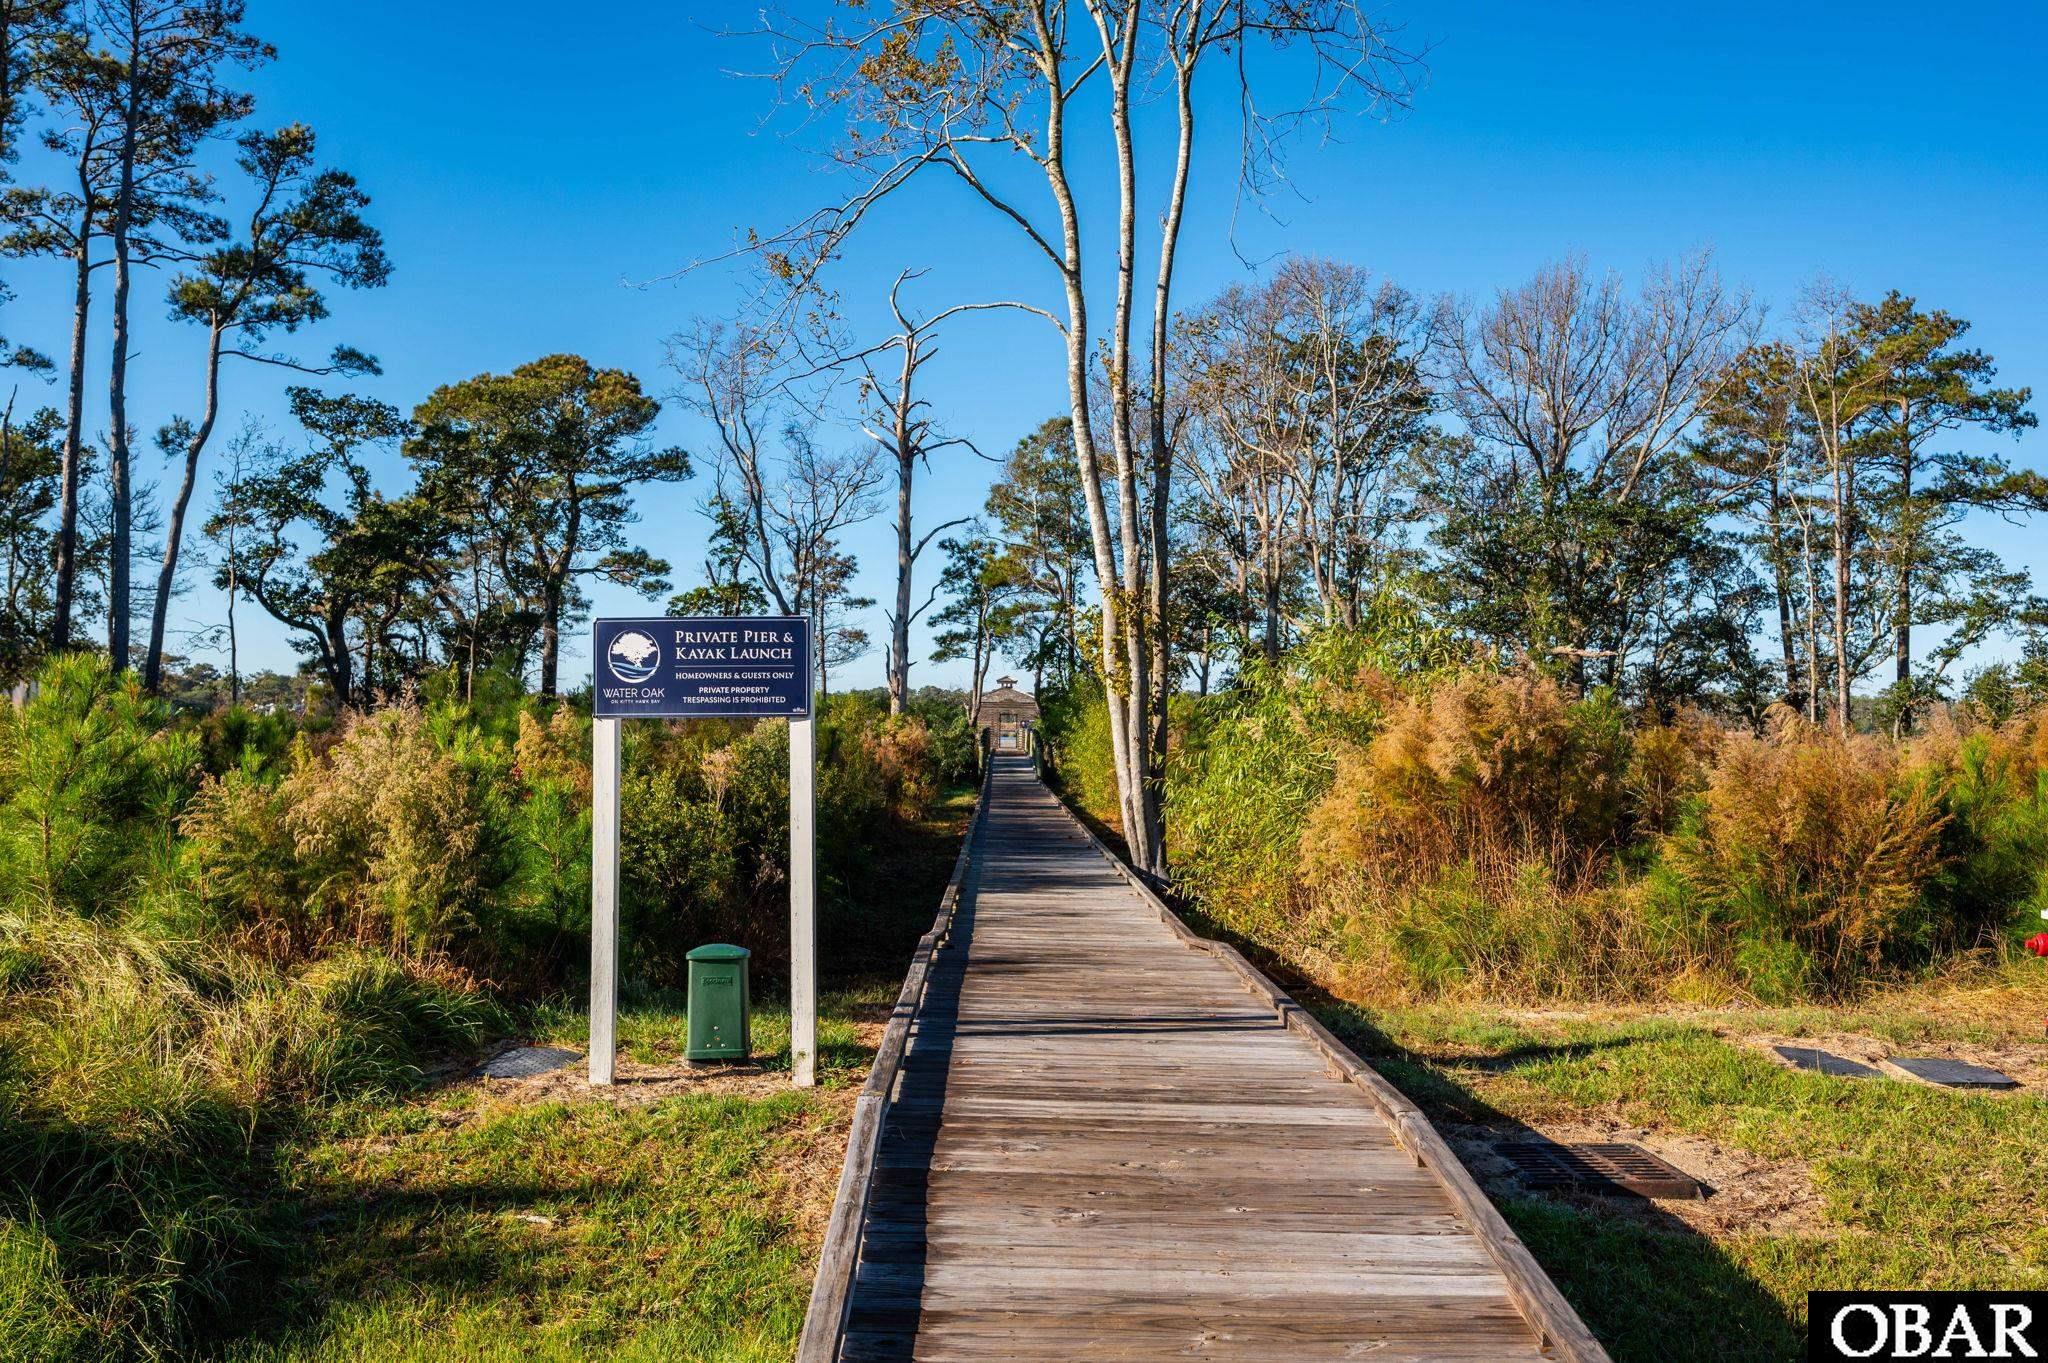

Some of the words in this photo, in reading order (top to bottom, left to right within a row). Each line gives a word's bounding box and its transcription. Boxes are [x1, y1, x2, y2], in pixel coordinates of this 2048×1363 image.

[675, 630, 738, 643] PRIVATE
[744, 630, 779, 643] PIER
[783, 632, 794, 643] &
[675, 647, 727, 660] KAYAK
[730, 647, 792, 660] LAUNCH
[676, 672, 732, 680] HOMEOWNERS
[602, 688, 638, 698] WATER
[641, 688, 665, 698] OAK
